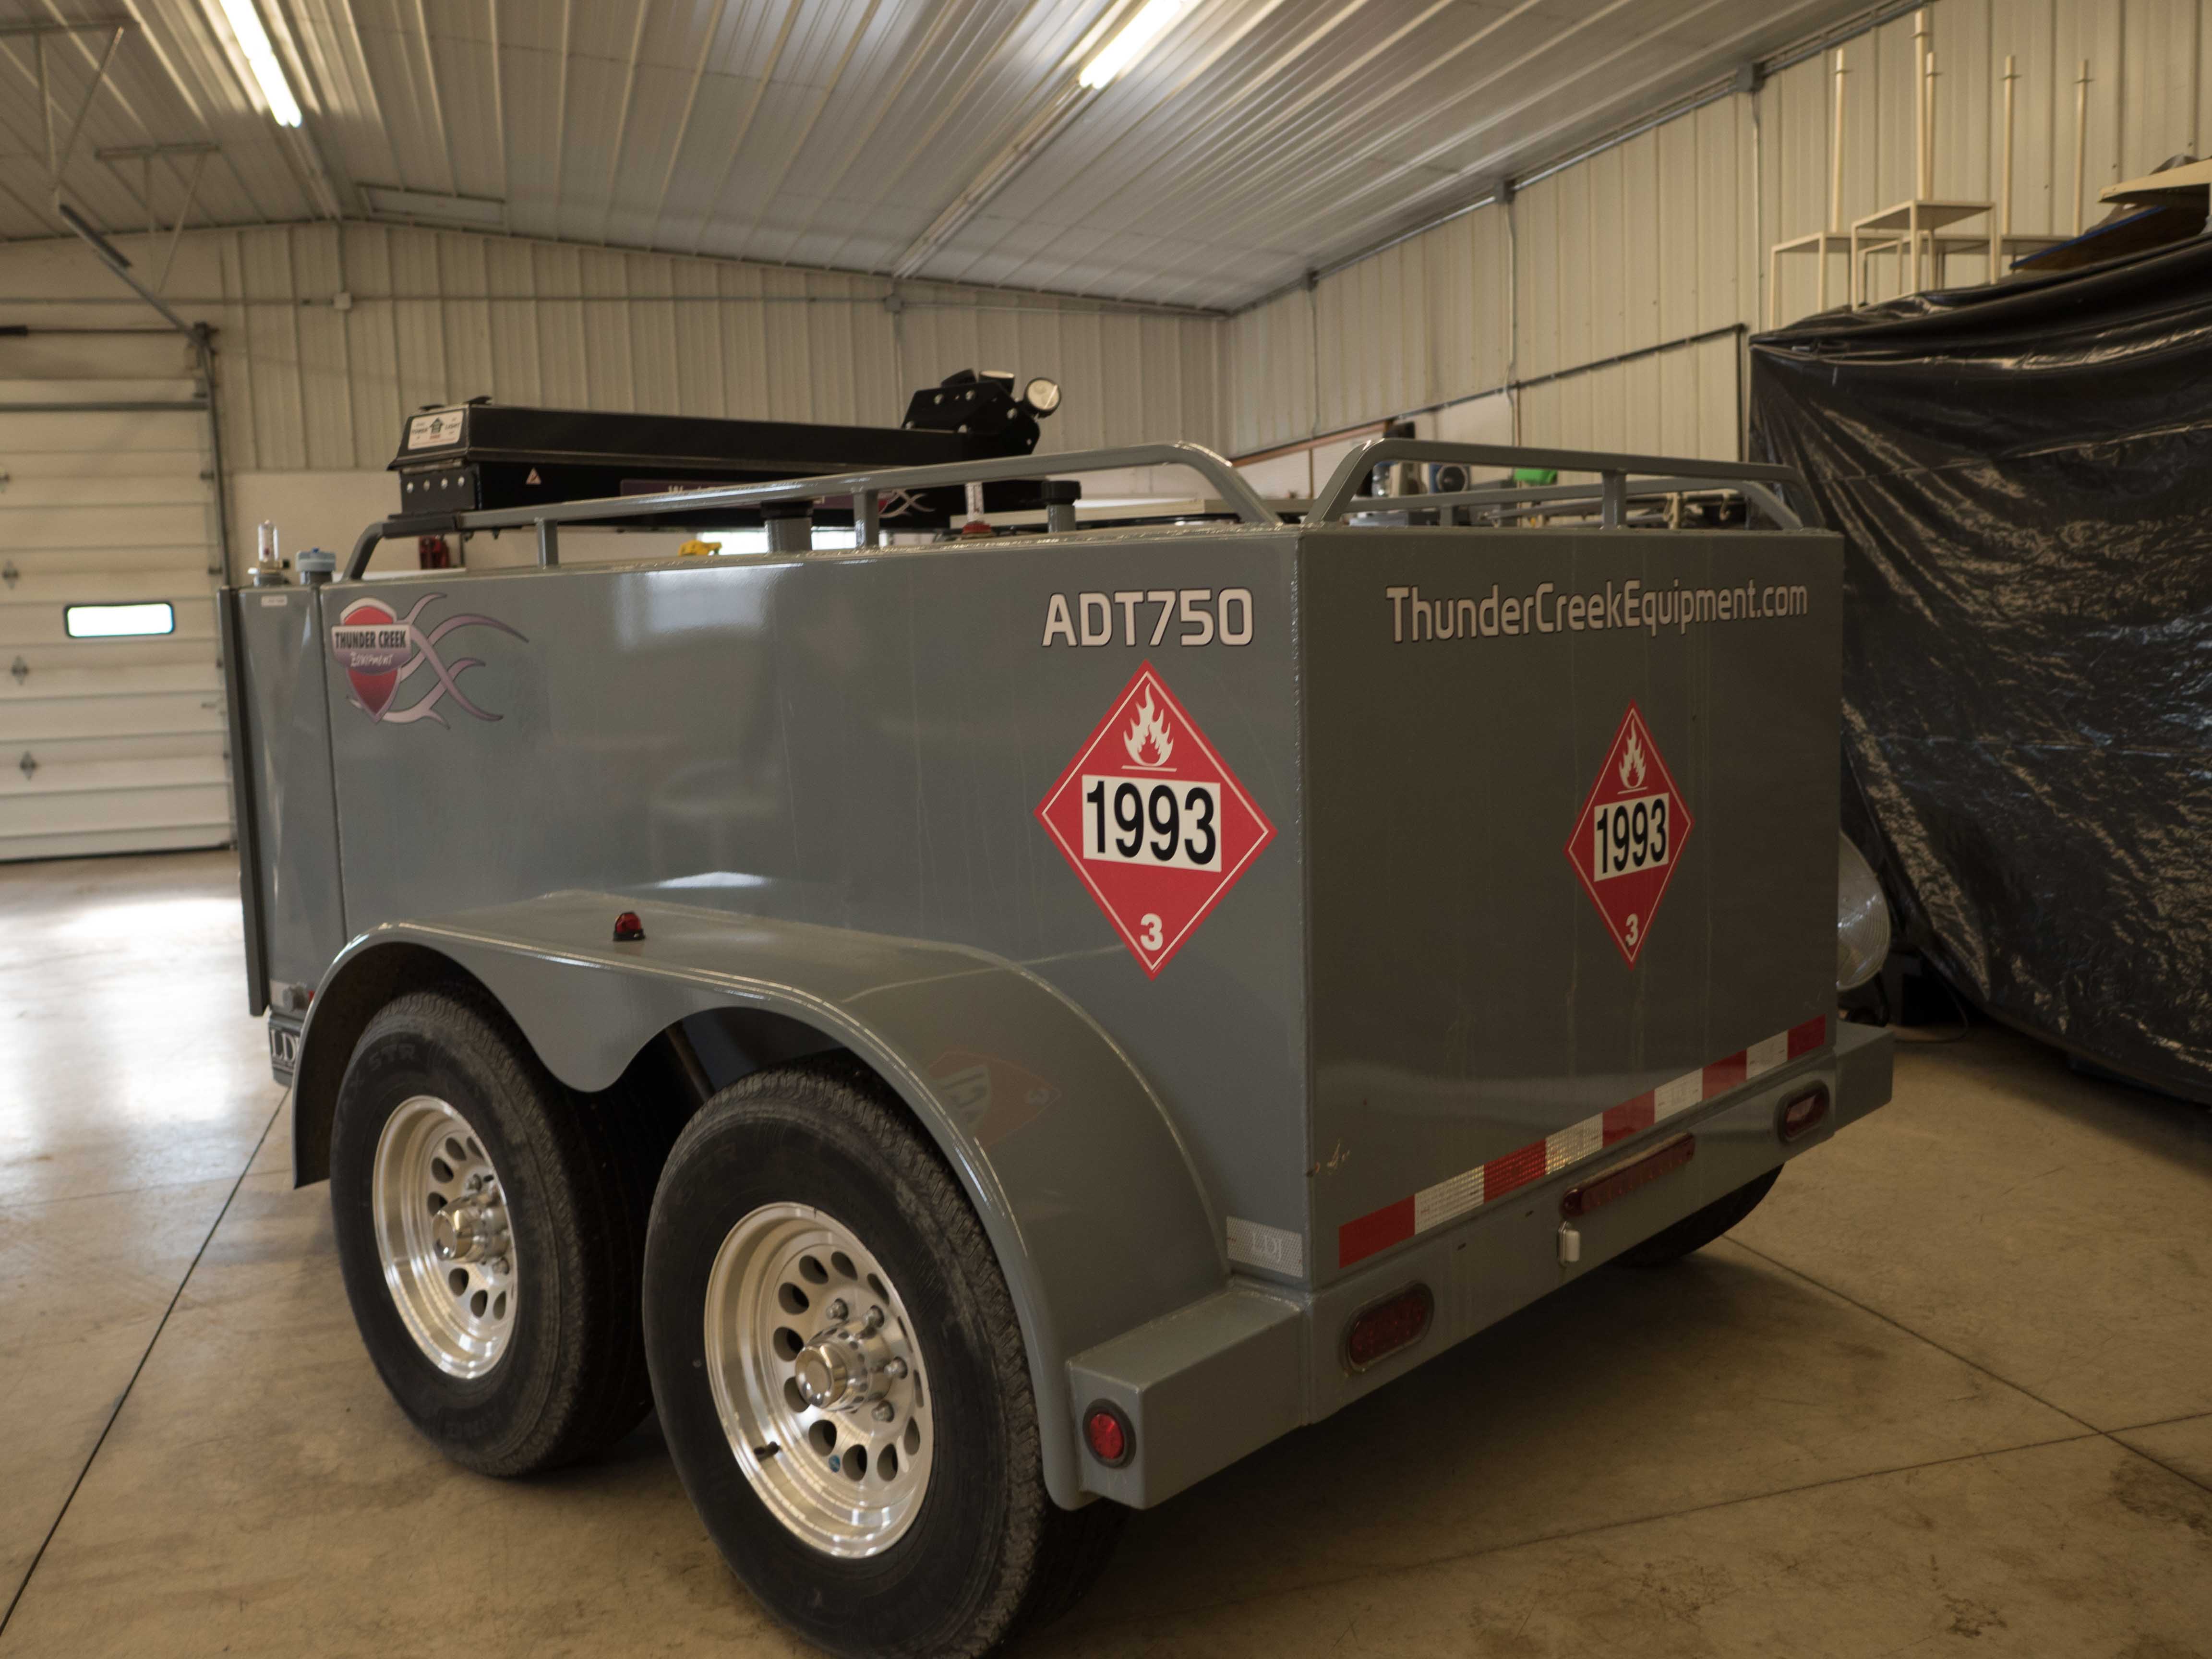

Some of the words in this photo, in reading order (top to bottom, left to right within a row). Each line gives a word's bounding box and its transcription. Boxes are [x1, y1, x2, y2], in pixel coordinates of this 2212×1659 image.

[335, 631, 376, 648] THUNDER
[378, 630, 407, 648] CREEK
[1041, 587, 1254, 647] ADT750
[1386, 579, 1809, 642] ThunderCreekEquipment.com
[1086, 780, 1217, 865] 1993
[1597, 798, 1667, 874] 1993
[1140, 913, 1164, 951] 3
[1625, 913, 1639, 947] 3
